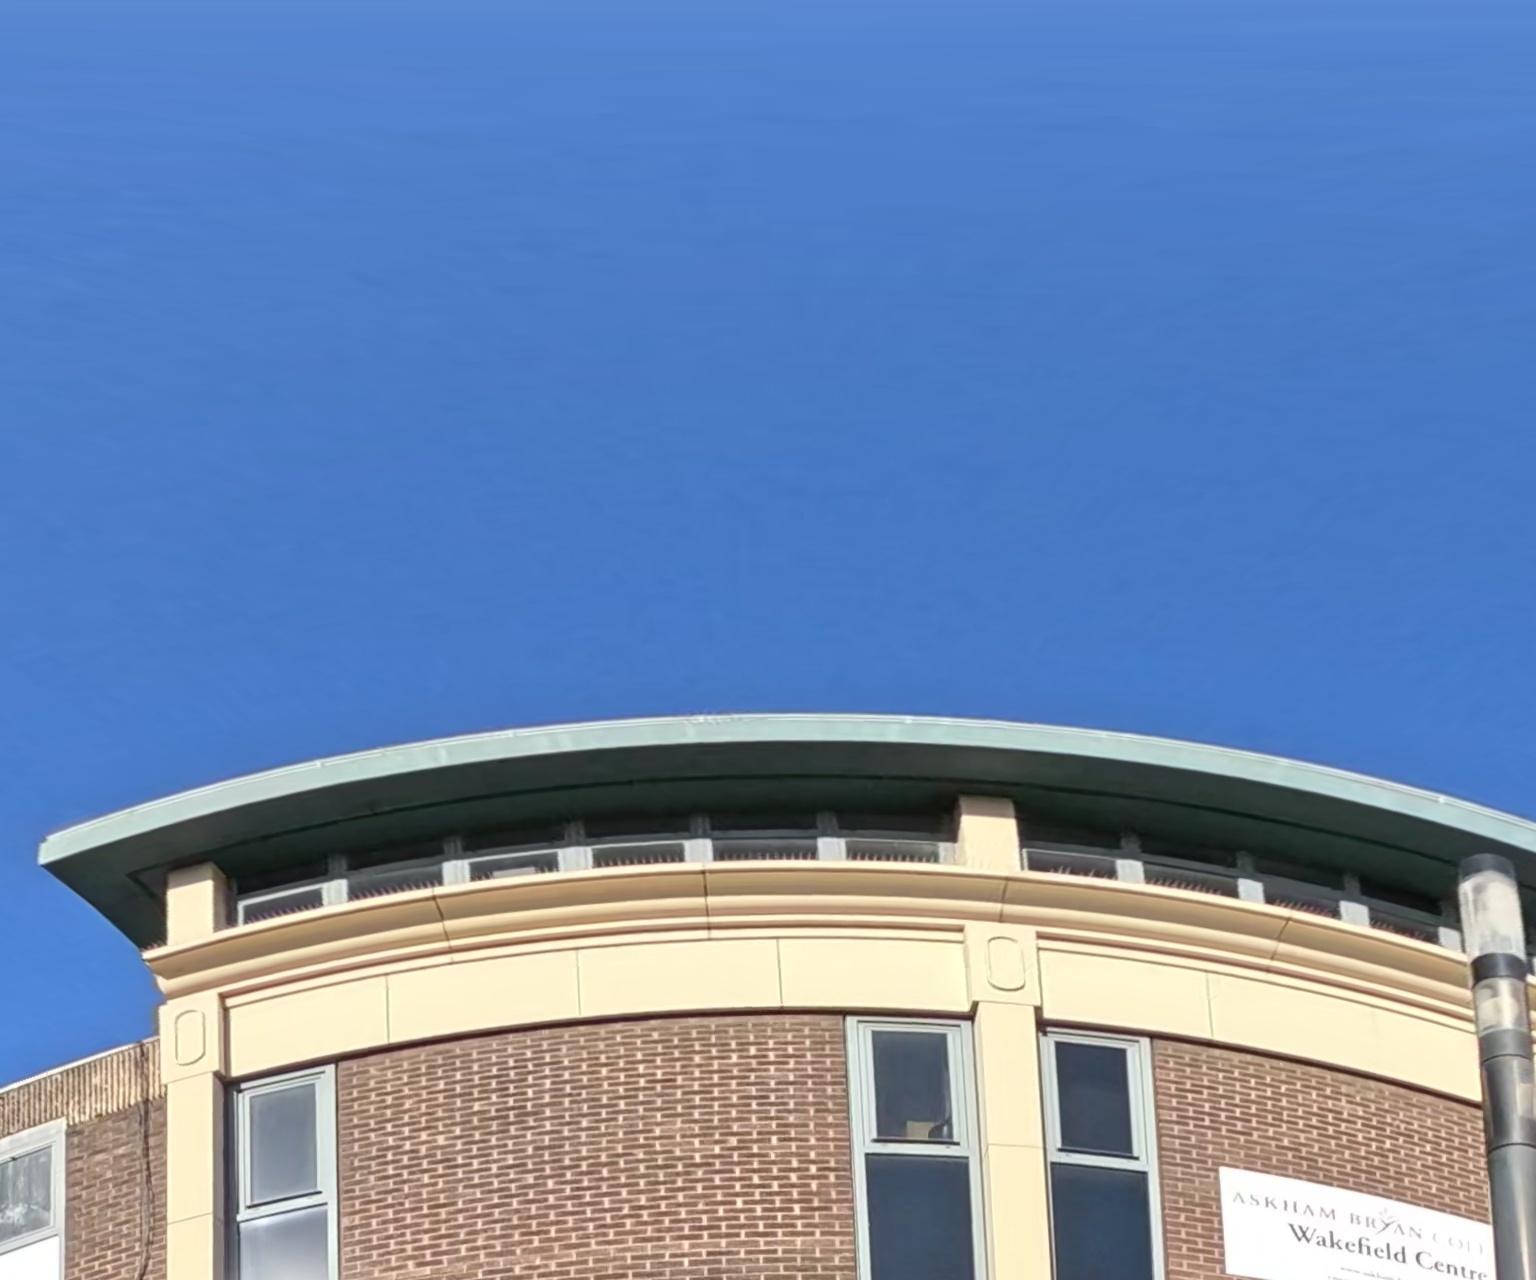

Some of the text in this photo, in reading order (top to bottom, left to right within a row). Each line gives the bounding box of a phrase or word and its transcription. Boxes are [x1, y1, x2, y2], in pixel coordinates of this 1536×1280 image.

[1232, 1191, 1337, 1222] ASKHAM
[1349, 1210, 1423, 1240] BRYAN
[1288, 1222, 1407, 1265] Wakefield
